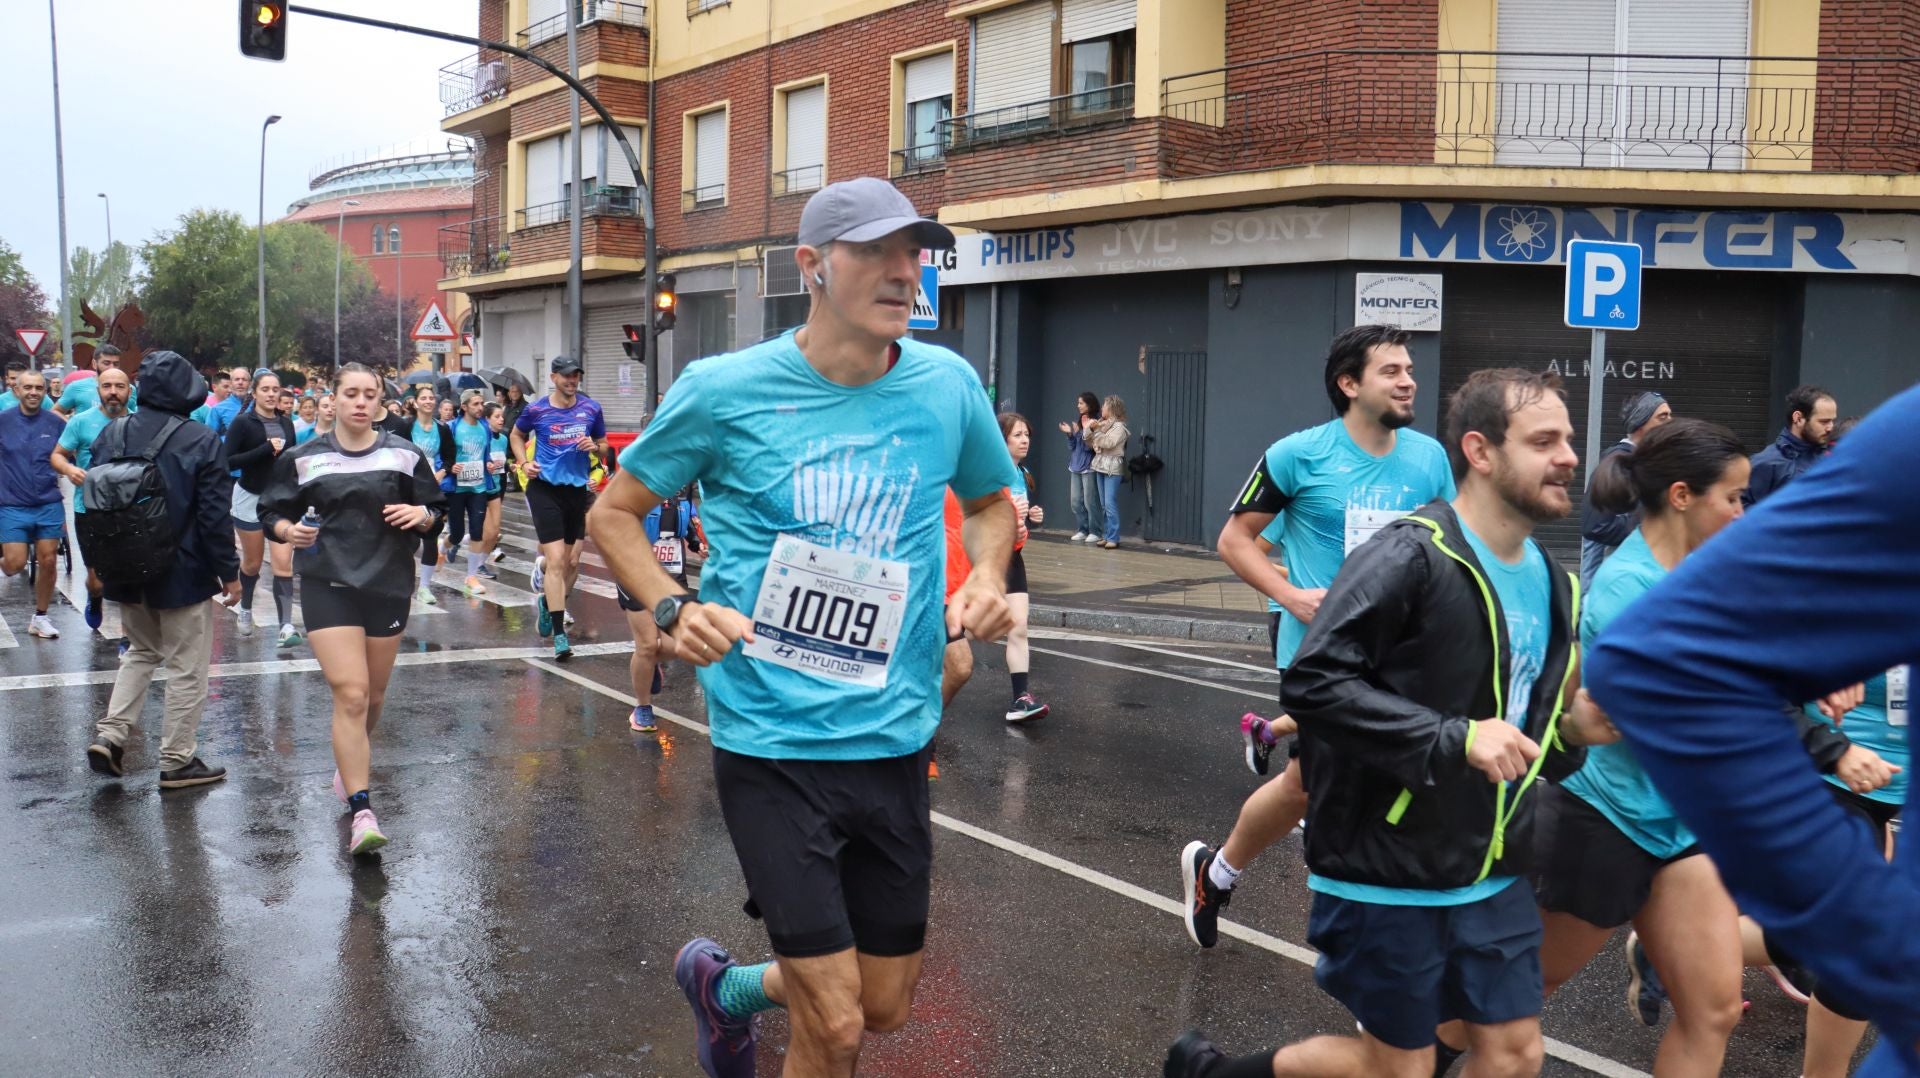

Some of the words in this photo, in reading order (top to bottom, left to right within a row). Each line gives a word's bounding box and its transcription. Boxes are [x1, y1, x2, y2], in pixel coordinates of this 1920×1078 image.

[981, 228, 1075, 266] PHILIPS
[1102, 221, 1177, 257] JVC
[1210, 212, 1330, 245] SONY
[1400, 204, 1858, 269] MONFER
[1096, 256, 1188, 272] TECNICA
[1583, 251, 1627, 317] P
[1360, 297, 1439, 309] MONFER
[783, 585, 880, 647] 1009
